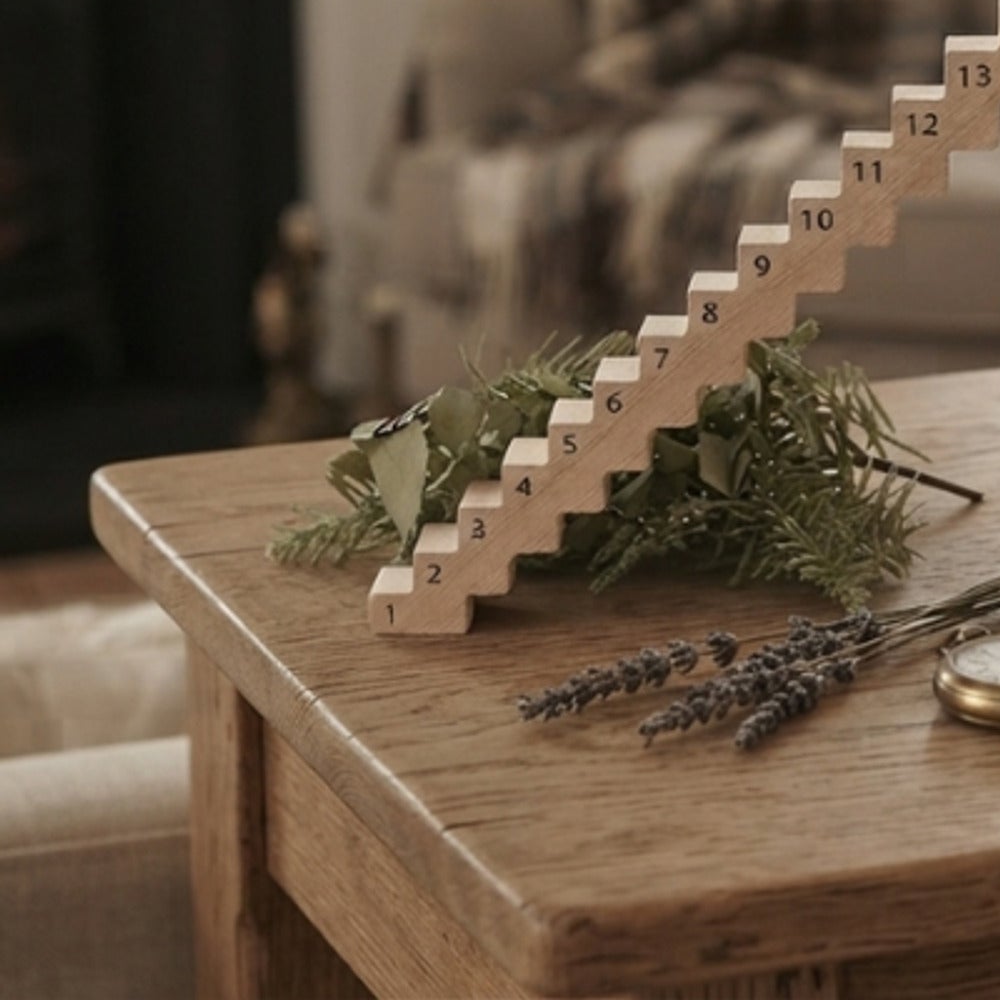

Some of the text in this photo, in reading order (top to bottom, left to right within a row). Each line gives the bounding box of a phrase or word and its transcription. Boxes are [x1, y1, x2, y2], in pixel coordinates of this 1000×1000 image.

[958, 63, 992, 88] 13
[907, 112, 939, 137] 12
[852, 160, 882, 184] 11
[801, 208, 834, 232] 10
[753, 254, 771, 278] 9
[701, 302, 719, 324] 8
[654, 347, 670, 370] 7
[605, 392, 623, 414] 6
[562, 433, 578, 455] 5
[515, 476, 532, 497] 4
[471, 517, 486, 540] 3
[427, 563, 442, 585] 2
[385, 602, 395, 626] 1
